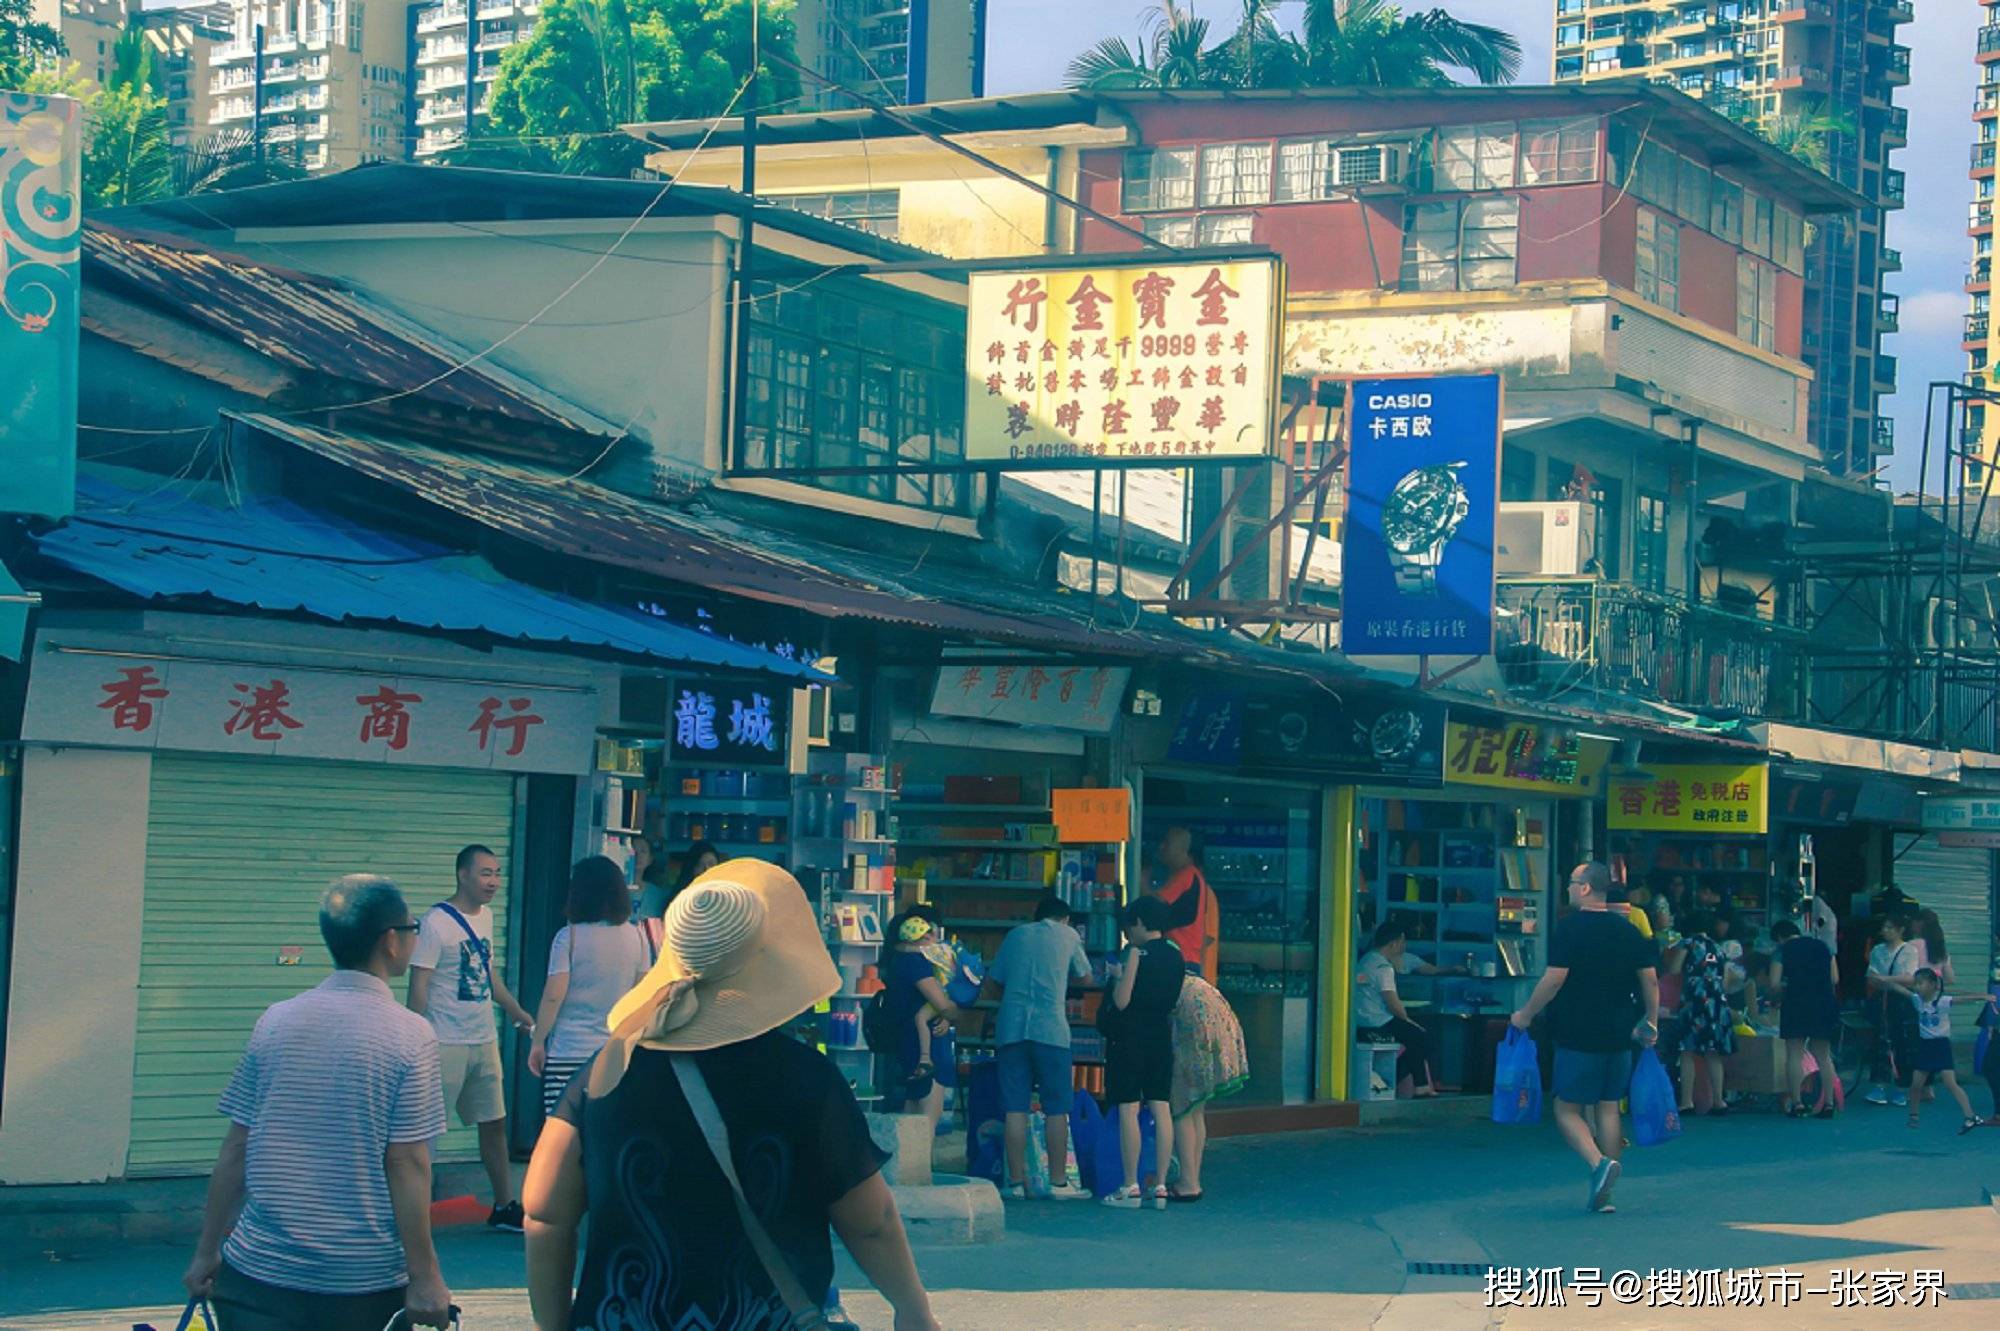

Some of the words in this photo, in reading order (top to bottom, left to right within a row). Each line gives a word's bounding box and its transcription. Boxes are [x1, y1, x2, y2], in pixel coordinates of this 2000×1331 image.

[1368, 393, 1432, 410] CASIO
[97, 664, 545, 756] 香港商行
[674, 689, 776, 751] 龍城
[1618, 779, 1683, 817] 香港
